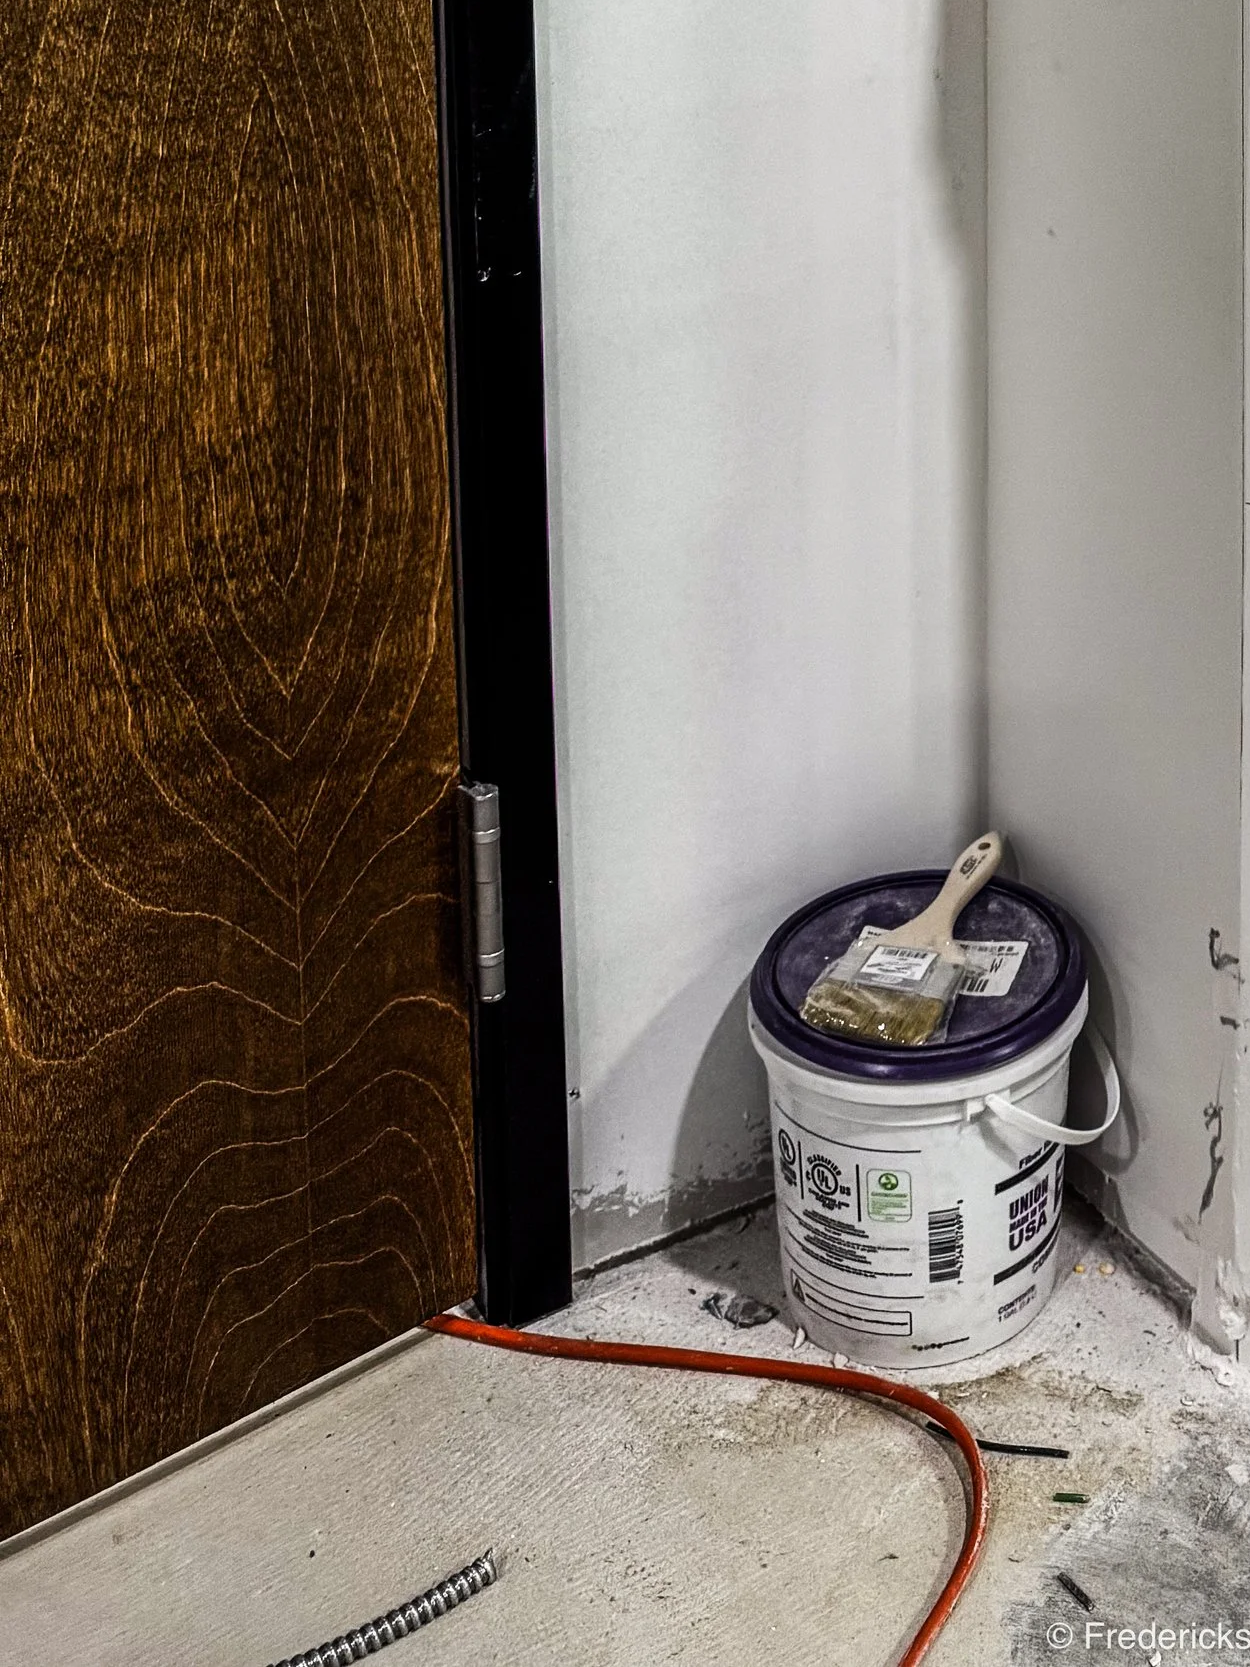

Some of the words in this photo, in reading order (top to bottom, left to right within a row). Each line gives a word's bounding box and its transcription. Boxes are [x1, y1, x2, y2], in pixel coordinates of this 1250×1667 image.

[840, 1185, 851, 1196] US
[1009, 1173, 1049, 1220] UNION
[1009, 1212, 1029, 1233] MADE
[1038, 1195, 1048, 1213] THE
[1009, 1209, 1047, 1251] USA
